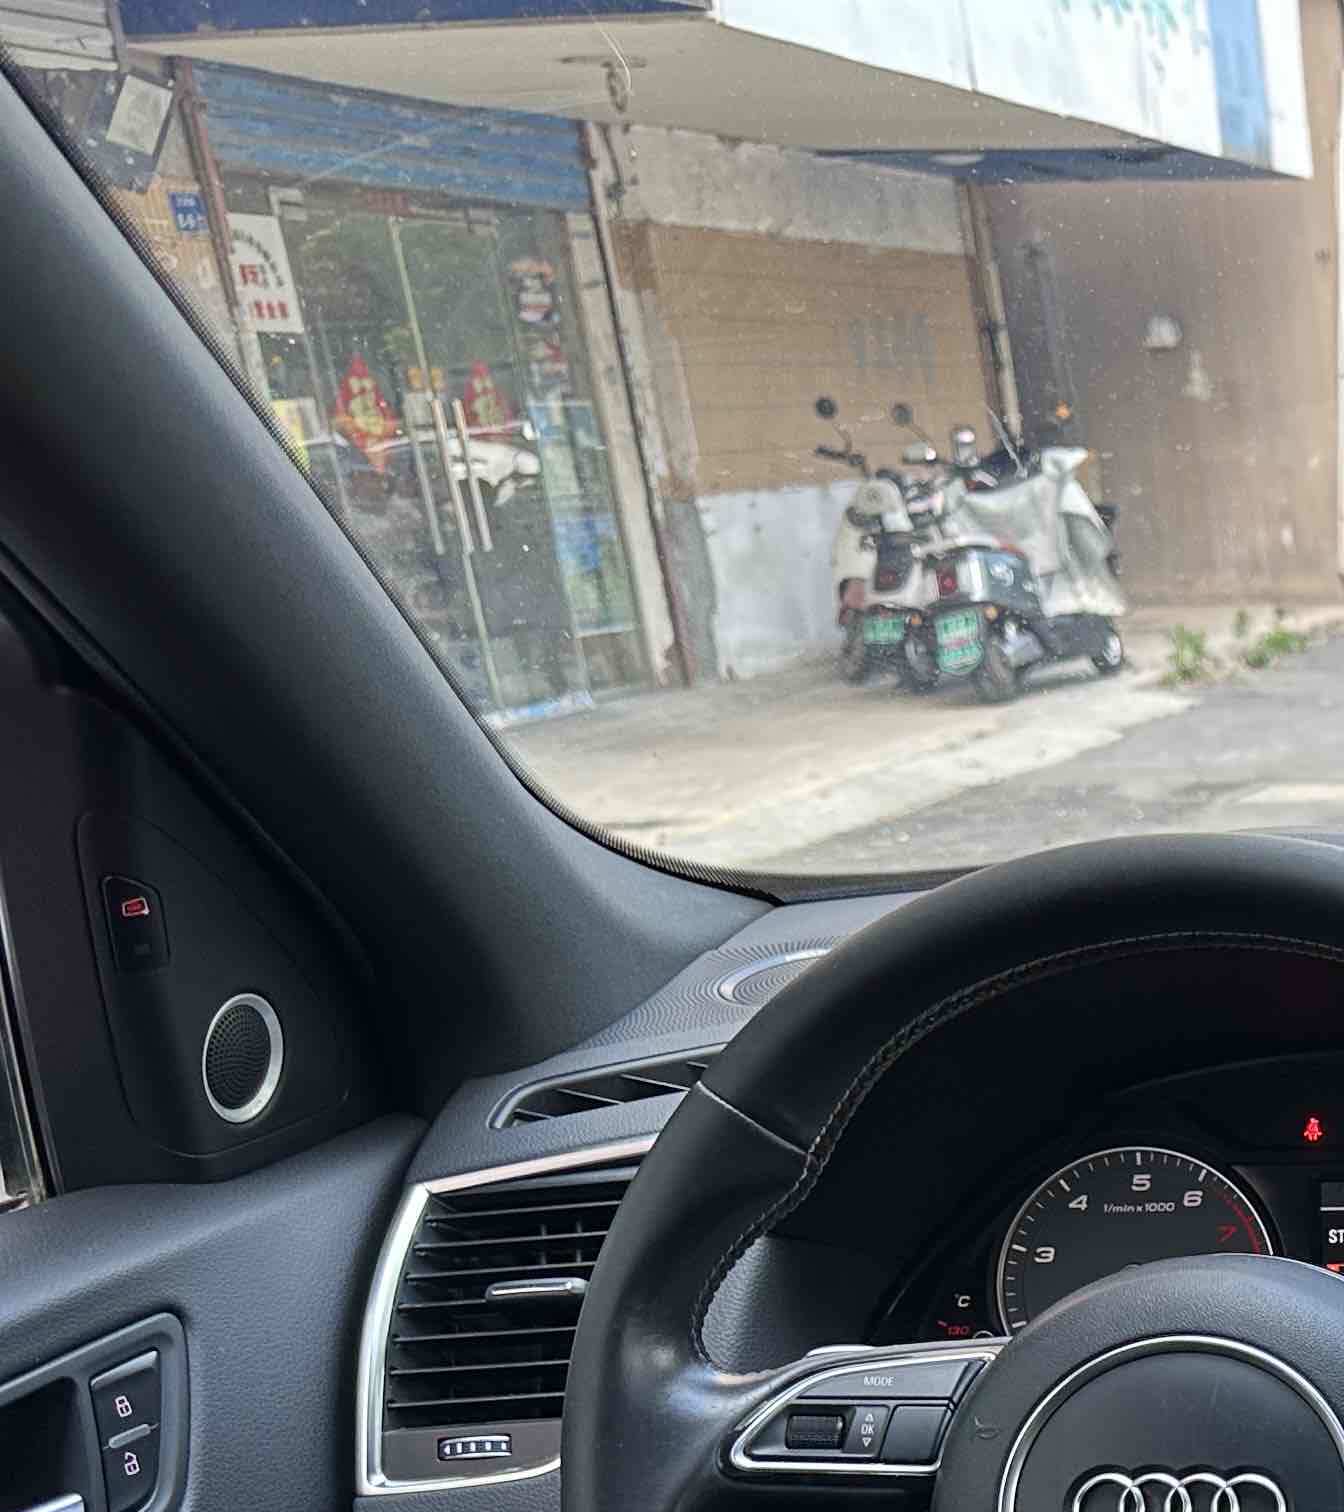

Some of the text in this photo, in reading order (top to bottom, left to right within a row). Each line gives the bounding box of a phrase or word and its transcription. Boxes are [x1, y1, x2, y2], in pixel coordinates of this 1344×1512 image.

[1131, 1174, 1152, 1191] 5
[1068, 1195, 1089, 1211] 4
[1183, 1190, 1203, 1207] 6
[1103, 1204, 1136, 1214] 1/min
[1145, 1202, 1176, 1213] 1000
[1216, 1224, 1238, 1242] 7
[1034, 1247, 1056, 1263] 3
[863, 1375, 896, 1386] MODE
[861, 1423, 875, 1435] OK
